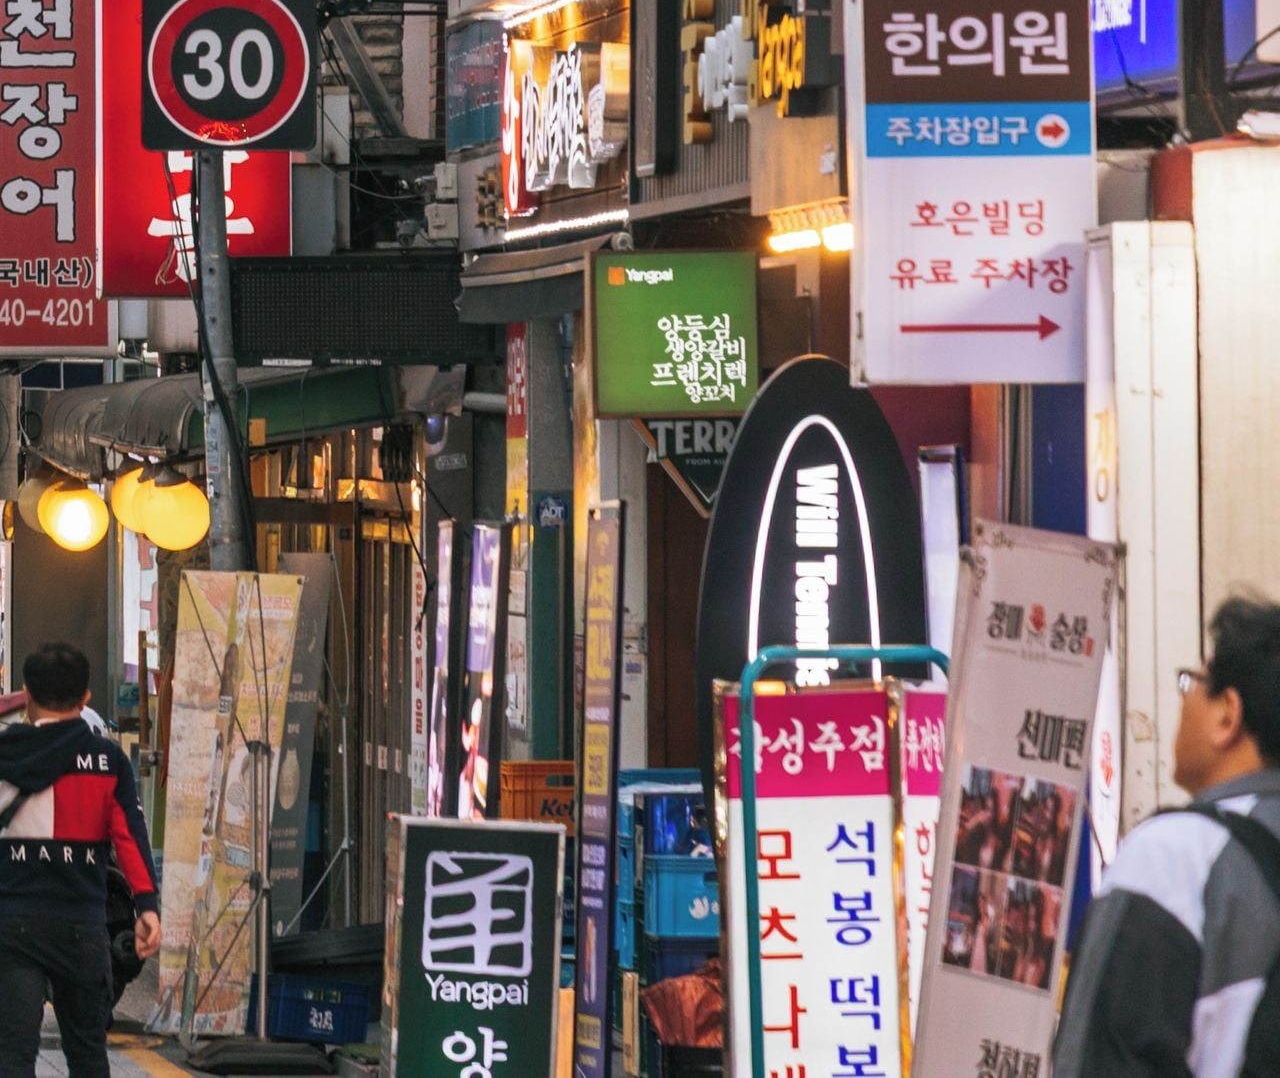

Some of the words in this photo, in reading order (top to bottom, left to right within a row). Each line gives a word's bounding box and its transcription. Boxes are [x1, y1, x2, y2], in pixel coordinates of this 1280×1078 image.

[883, 12, 1070, 76] 한의원
[181, 28, 276, 101] 30
[886, 117, 1029, 146] 주차장입구
[910, 200, 1044, 236] 호은빌딩
[889, 258, 958, 289] 유료
[971, 256, 1073, 294] 주차장
[657, 313, 730, 340] 양등심
[665, 336, 746, 362] 생양갈비
[685, 381, 735, 403] 양꼬치
[796, 464, 838, 548] Will
[76, 754, 110, 771] ME
[10, 845, 97, 866] MARK
[425, 973, 529, 1011] Yangpai
